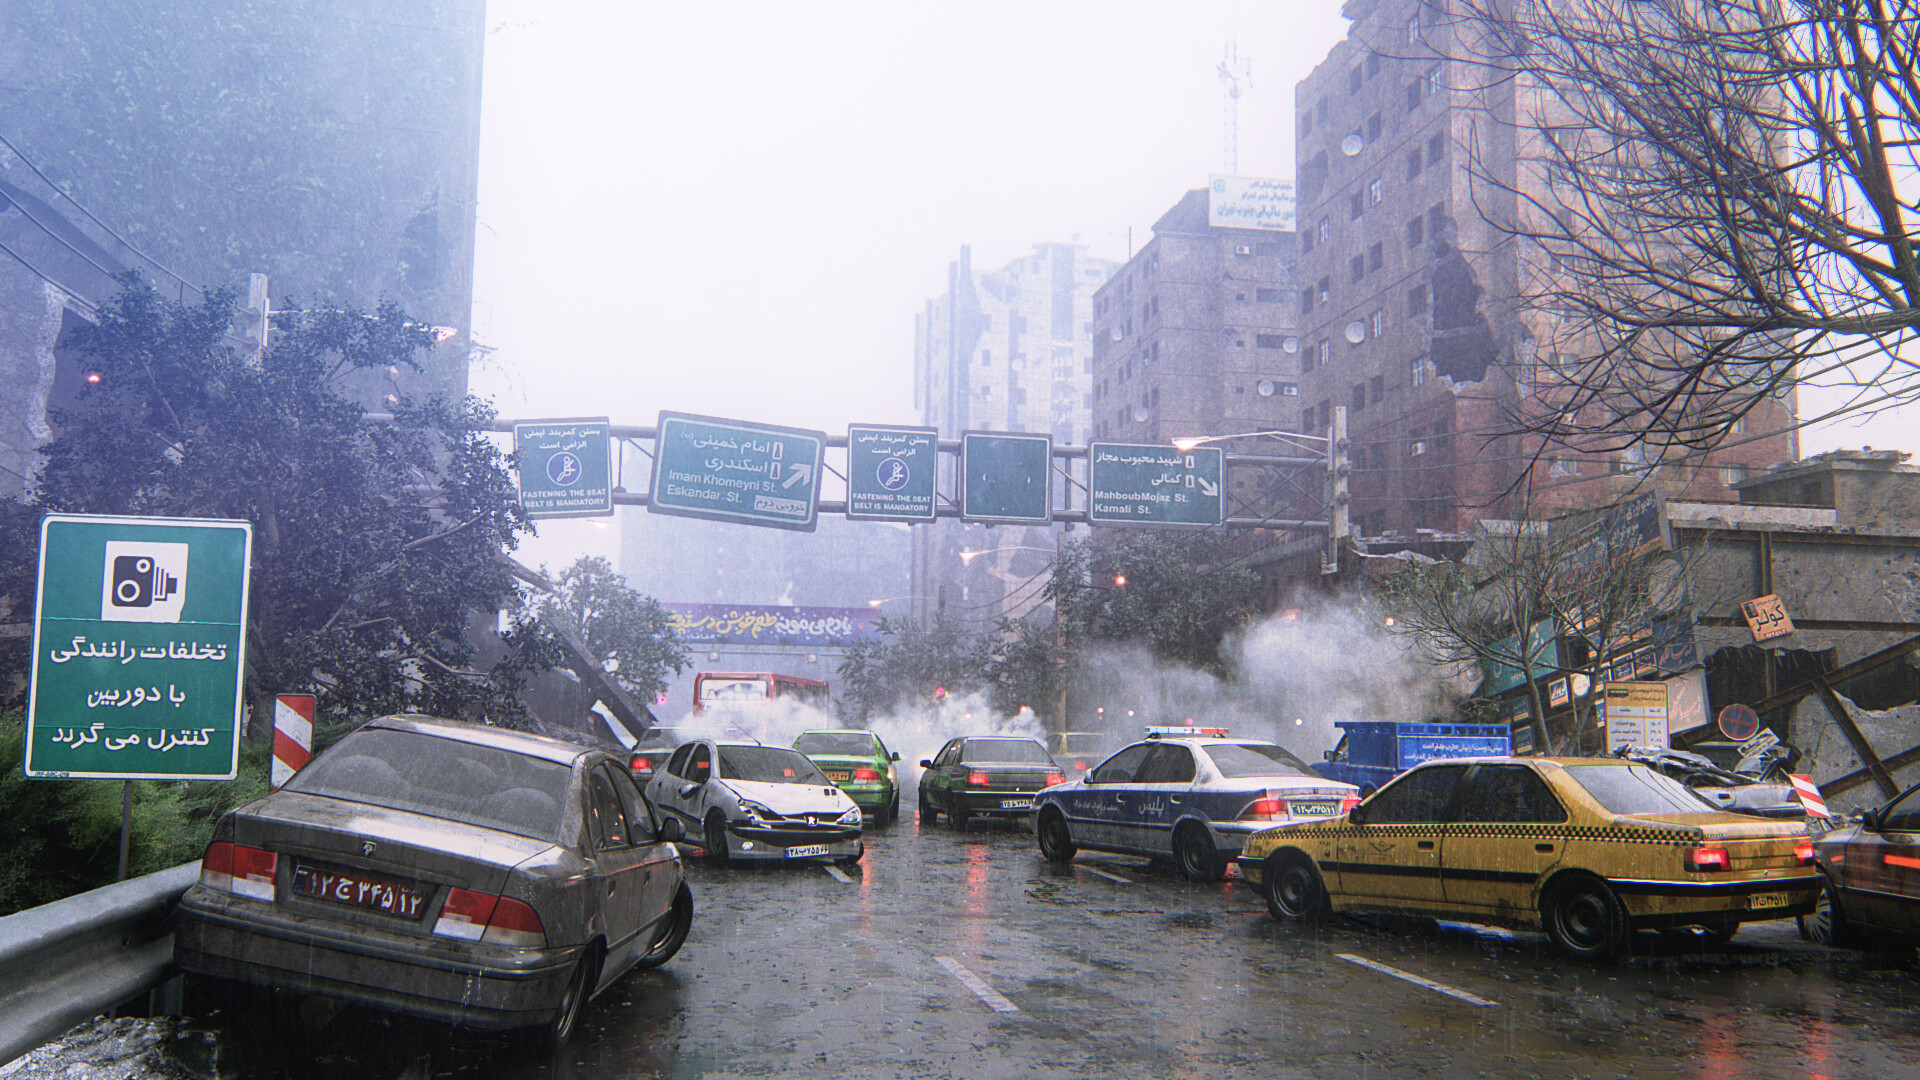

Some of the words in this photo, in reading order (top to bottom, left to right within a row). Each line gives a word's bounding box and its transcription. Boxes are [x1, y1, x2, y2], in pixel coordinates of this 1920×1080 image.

[524, 429, 545, 438] ایمنی
[548, 428, 576, 438] کمربند
[578, 428, 600, 438] بستن
[858, 434, 878, 442] ایمنی
[694, 435, 738, 450] خمینی
[881, 435, 907, 444] کمربند
[909, 436, 929, 446] بستن
[562, 440, 586, 450] الزامی
[740, 440, 770, 455] امام
[893, 448, 916, 456] الزامی
[1096, 452, 1118, 463] مجاز
[1120, 456, 1154, 466] محبوب
[1157, 456, 1182, 466] شهید
[704, 457, 768, 473] اسکندری
[668, 470, 701, 483] Imam
[704, 474, 760, 491] Khomeyni
[762, 481, 778, 493] St.
[1152, 473, 1182, 486] کمالی
[522, 490, 566, 498] FASTENING
[586, 488, 606, 496] SEAT
[726, 492, 742, 503] St.
[853, 492, 894, 501] FASTENING
[556, 498, 604, 506] MANDATORY
[1174, 494, 1188, 503] St.
[884, 503, 929, 511] MANDATORY
[1095, 504, 1131, 513] Kamali
[1138, 505, 1151, 514] St.
[1755, 604, 1784, 632] کولر
[50, 636, 136, 665] رانندگی
[139, 640, 227, 662] تخلفات
[87, 685, 162, 708] دوربین
[169, 684, 186, 708] با
[147, 728, 215, 752] کنترل
[1138, 796, 1164, 818] پلیس
